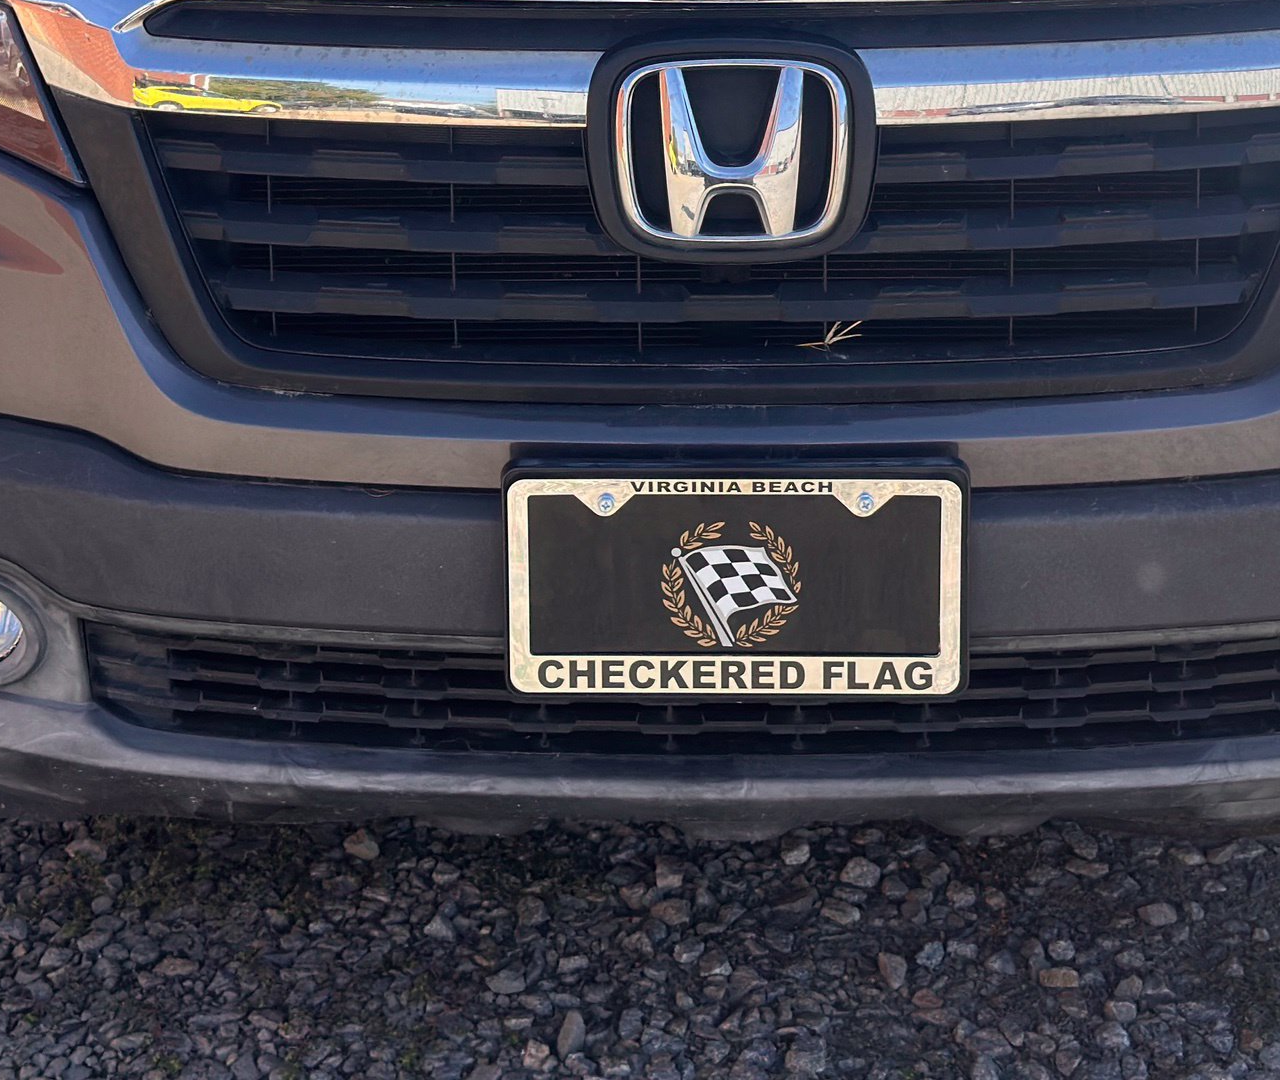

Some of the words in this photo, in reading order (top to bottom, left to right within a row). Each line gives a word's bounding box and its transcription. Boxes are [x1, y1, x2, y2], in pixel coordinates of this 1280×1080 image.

[631, 481, 741, 493] VIRGINIA
[751, 481, 833, 493] BEACH
[537, 659, 806, 690] CHECKERED
[822, 660, 934, 690] FLAG
